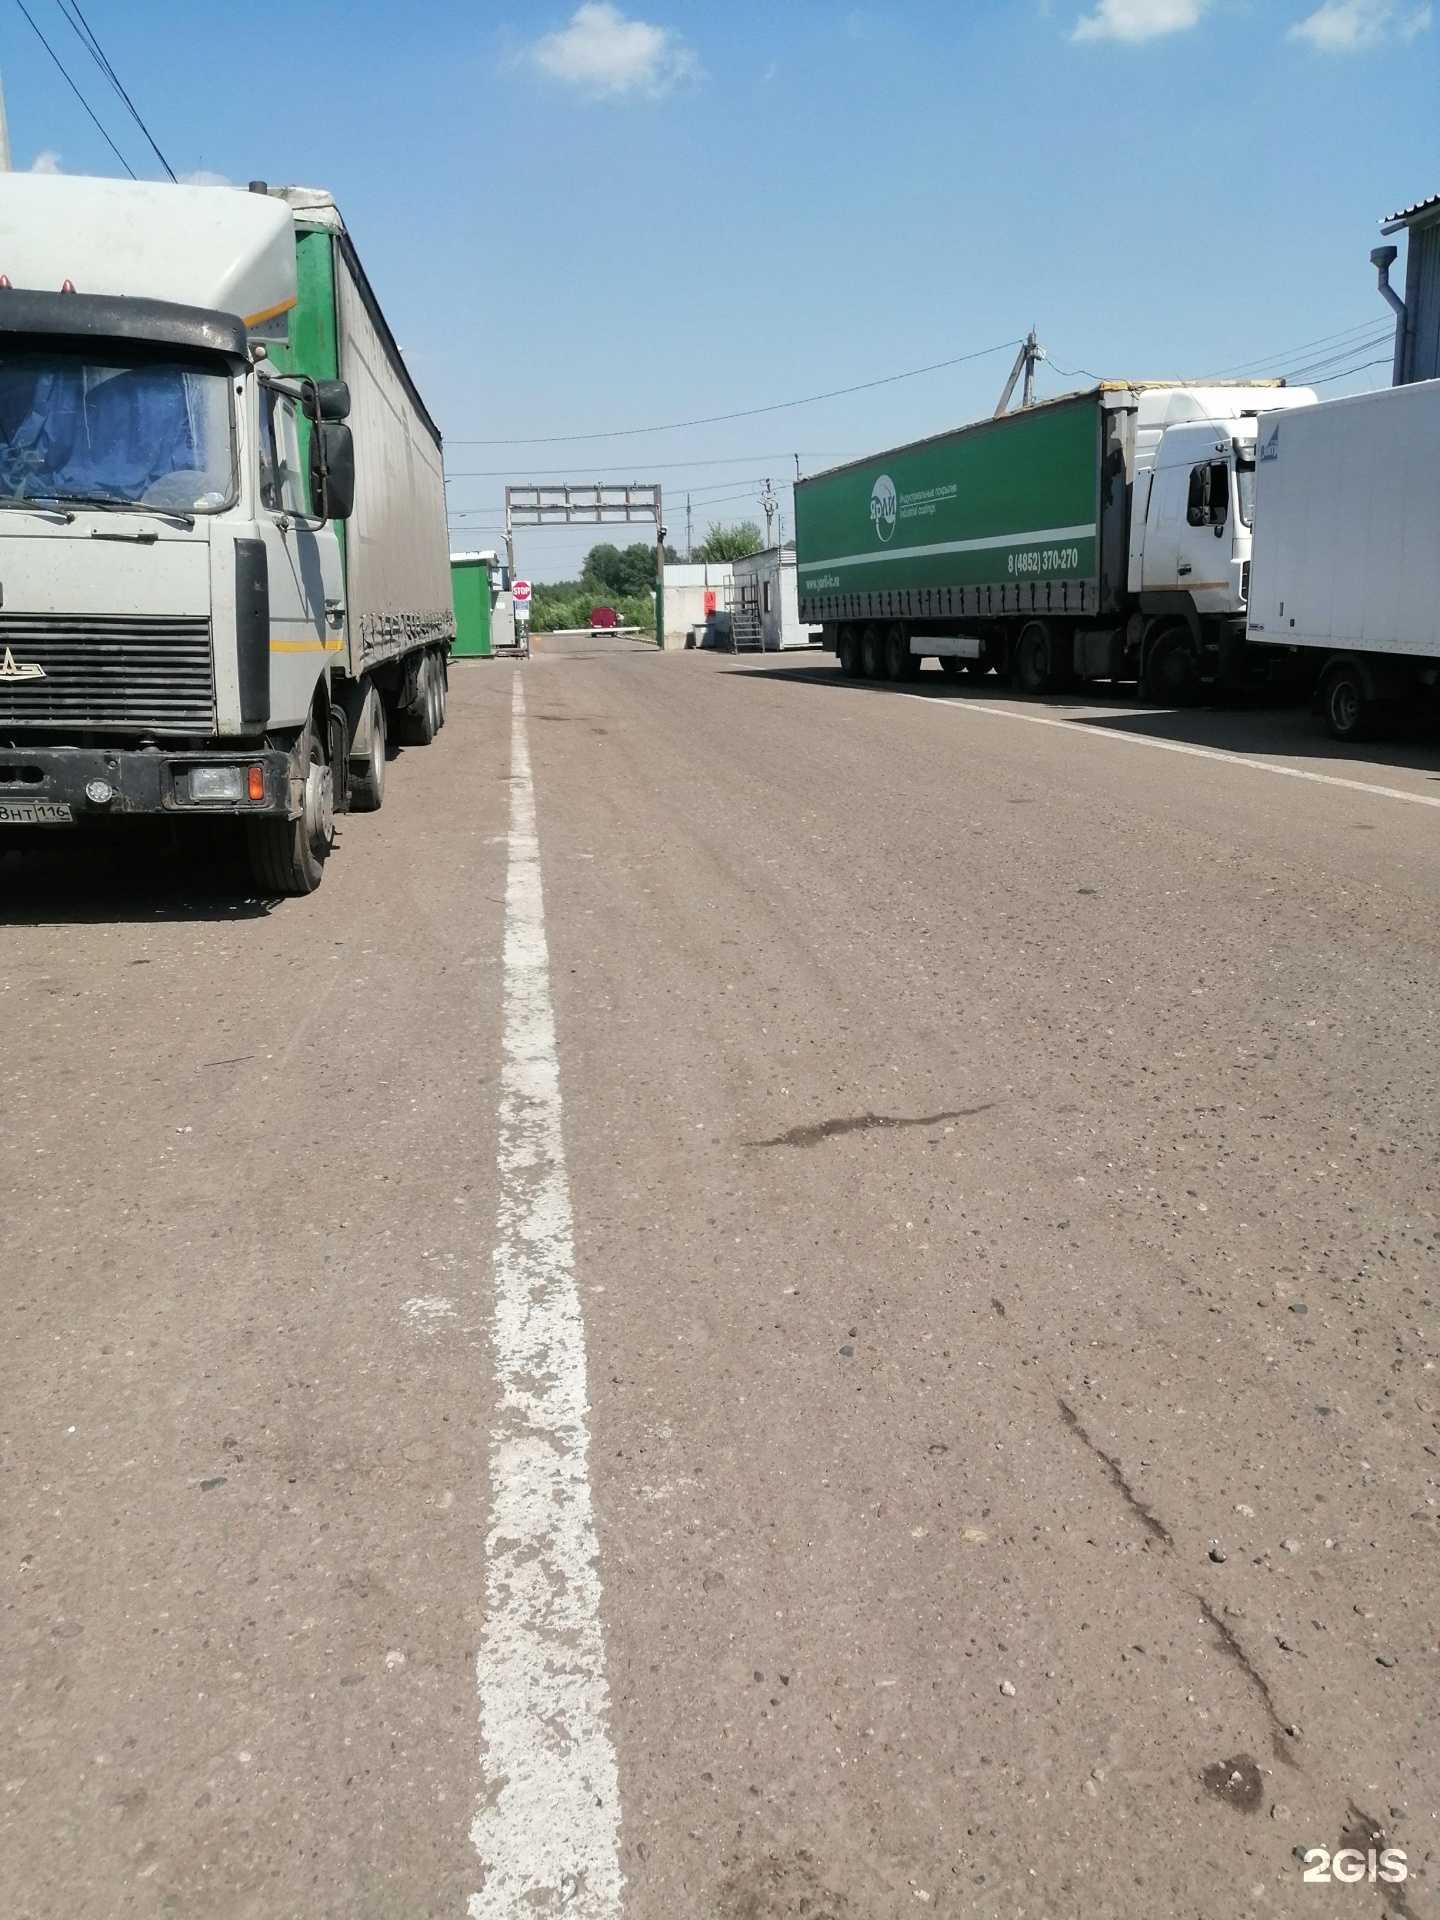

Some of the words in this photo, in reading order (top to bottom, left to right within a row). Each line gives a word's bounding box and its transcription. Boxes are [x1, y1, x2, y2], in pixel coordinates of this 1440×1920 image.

[1007, 553, 1014, 573] 8
[1014, 551, 1041, 576] (4852)
[1042, 547, 1078, 570] 370-270
[513, 586, 530, 595] STOP
[38, 806, 66, 817] 116
